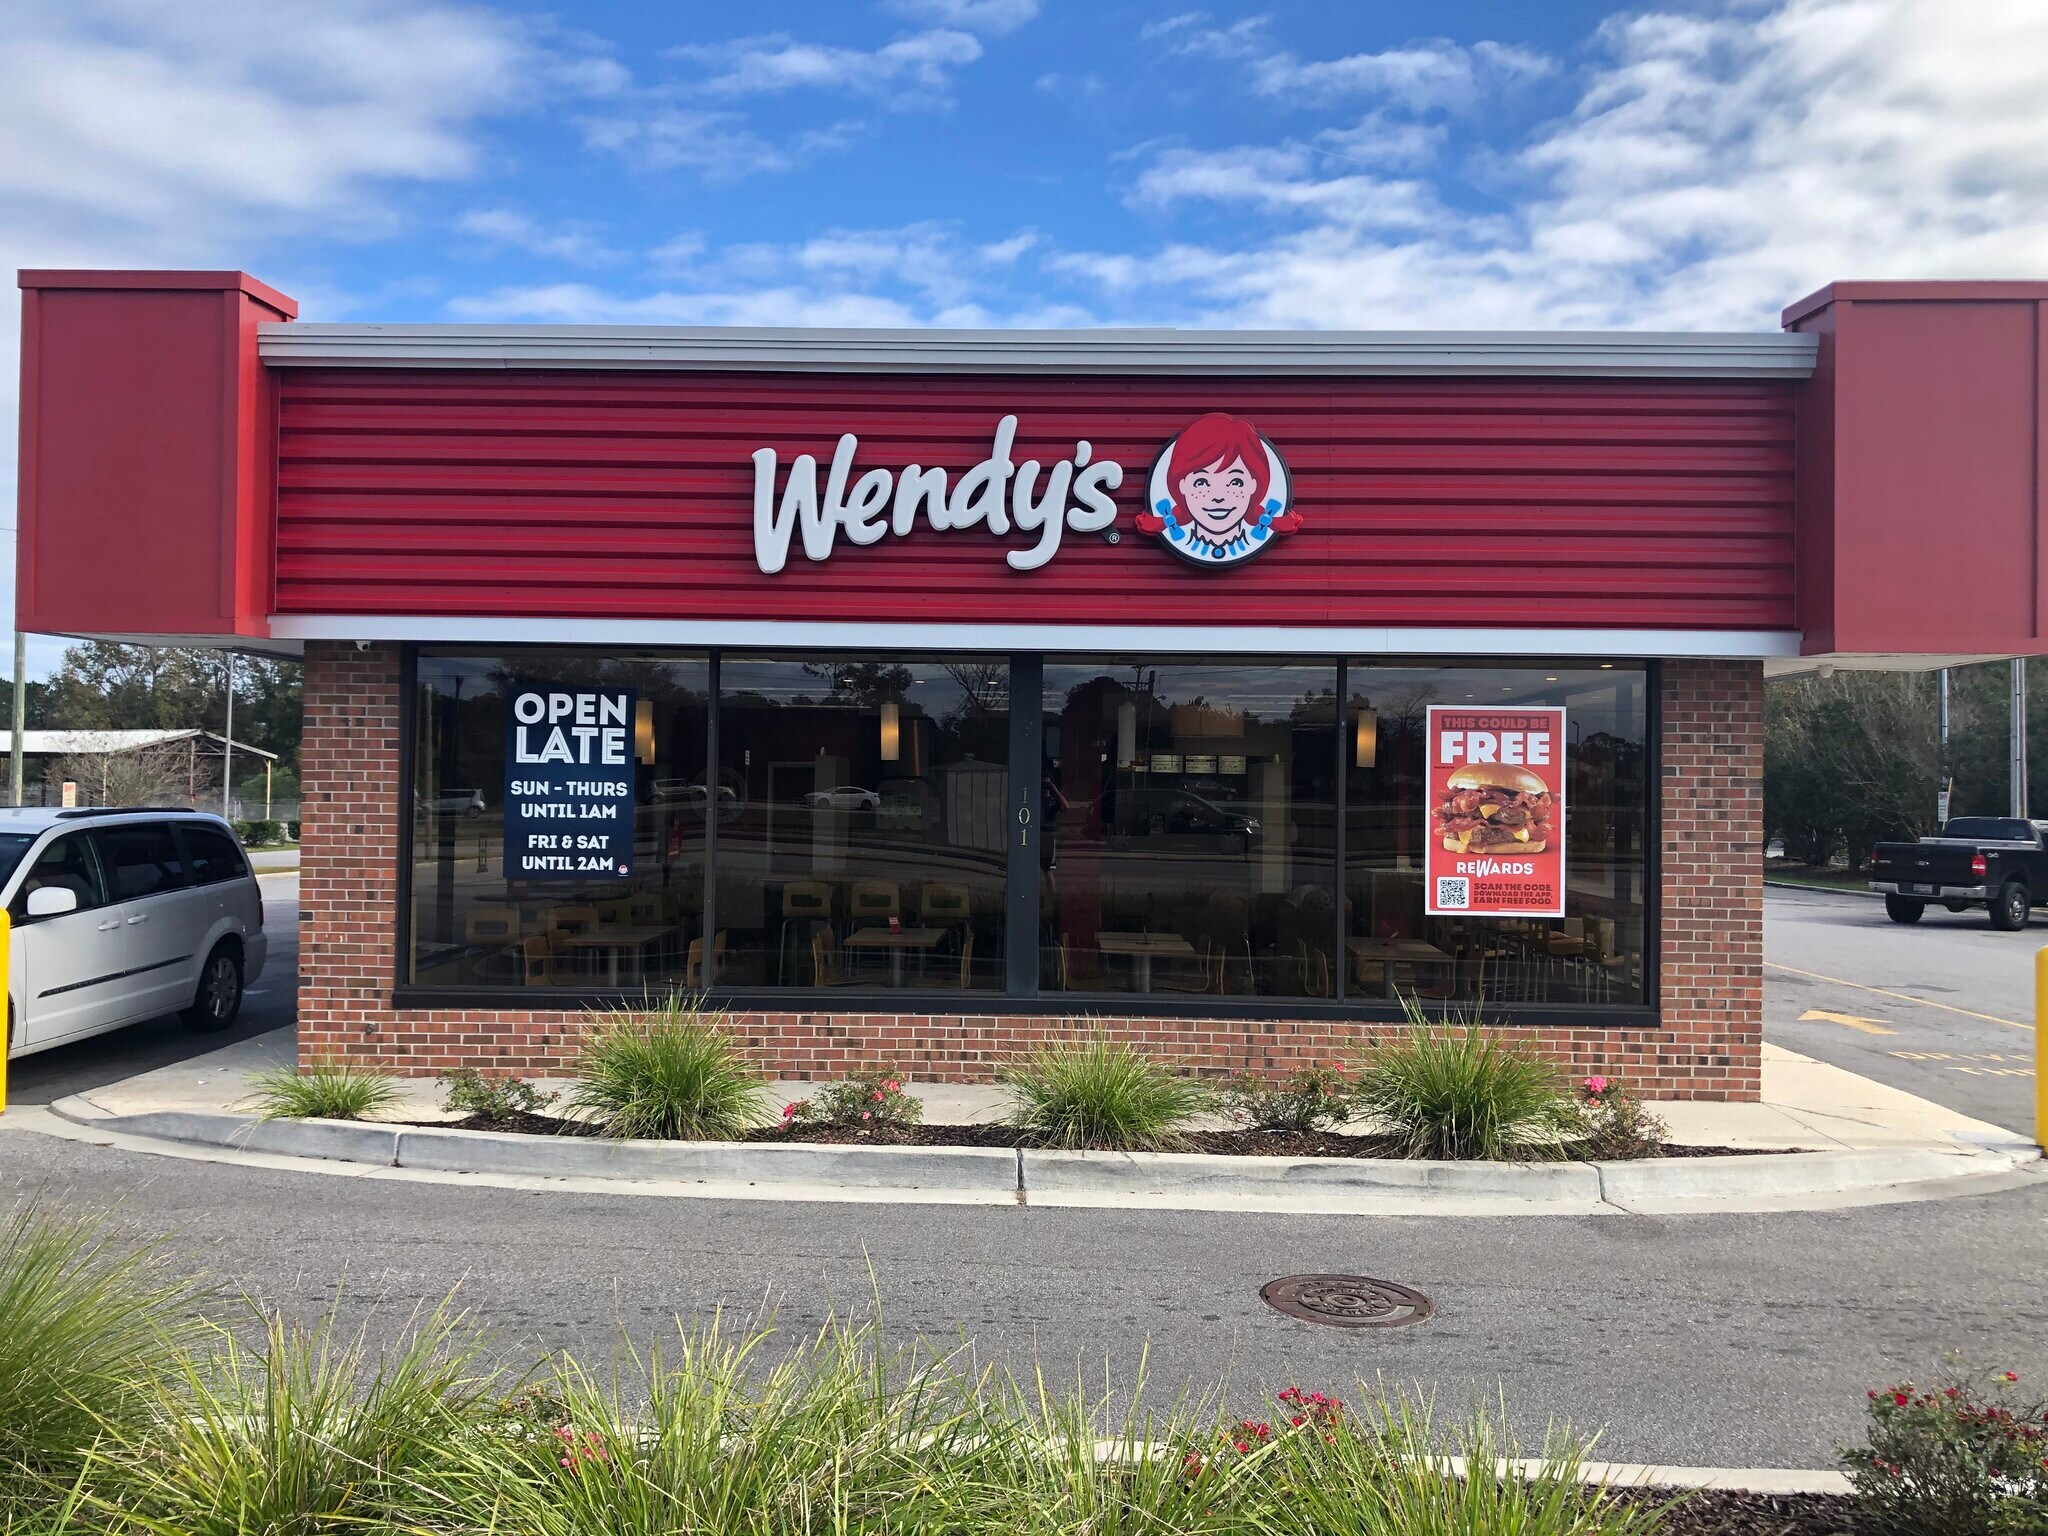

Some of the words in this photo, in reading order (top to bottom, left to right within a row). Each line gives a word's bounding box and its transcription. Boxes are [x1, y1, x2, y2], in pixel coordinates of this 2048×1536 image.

[751, 414, 1124, 574] Wendy's
[514, 693, 627, 725] OPEN
[1444, 717, 1475, 728] THIS
[1478, 718, 1527, 729] COULD
[1530, 718, 1547, 729] BE
[515, 726, 625, 764] LATE
[1440, 731, 1550, 765] FREE
[511, 781, 548, 796] SUN
[566, 781, 627, 796] THURS
[521, 804, 576, 818] UNTIL
[580, 804, 616, 818] 1AM
[1018, 787, 1030, 846] 101
[528, 835, 557, 848] FRI
[562, 835, 573, 848] &
[577, 835, 609, 849] SAT
[522, 856, 574, 870] UNTIL
[578, 857, 613, 870] 2AM
